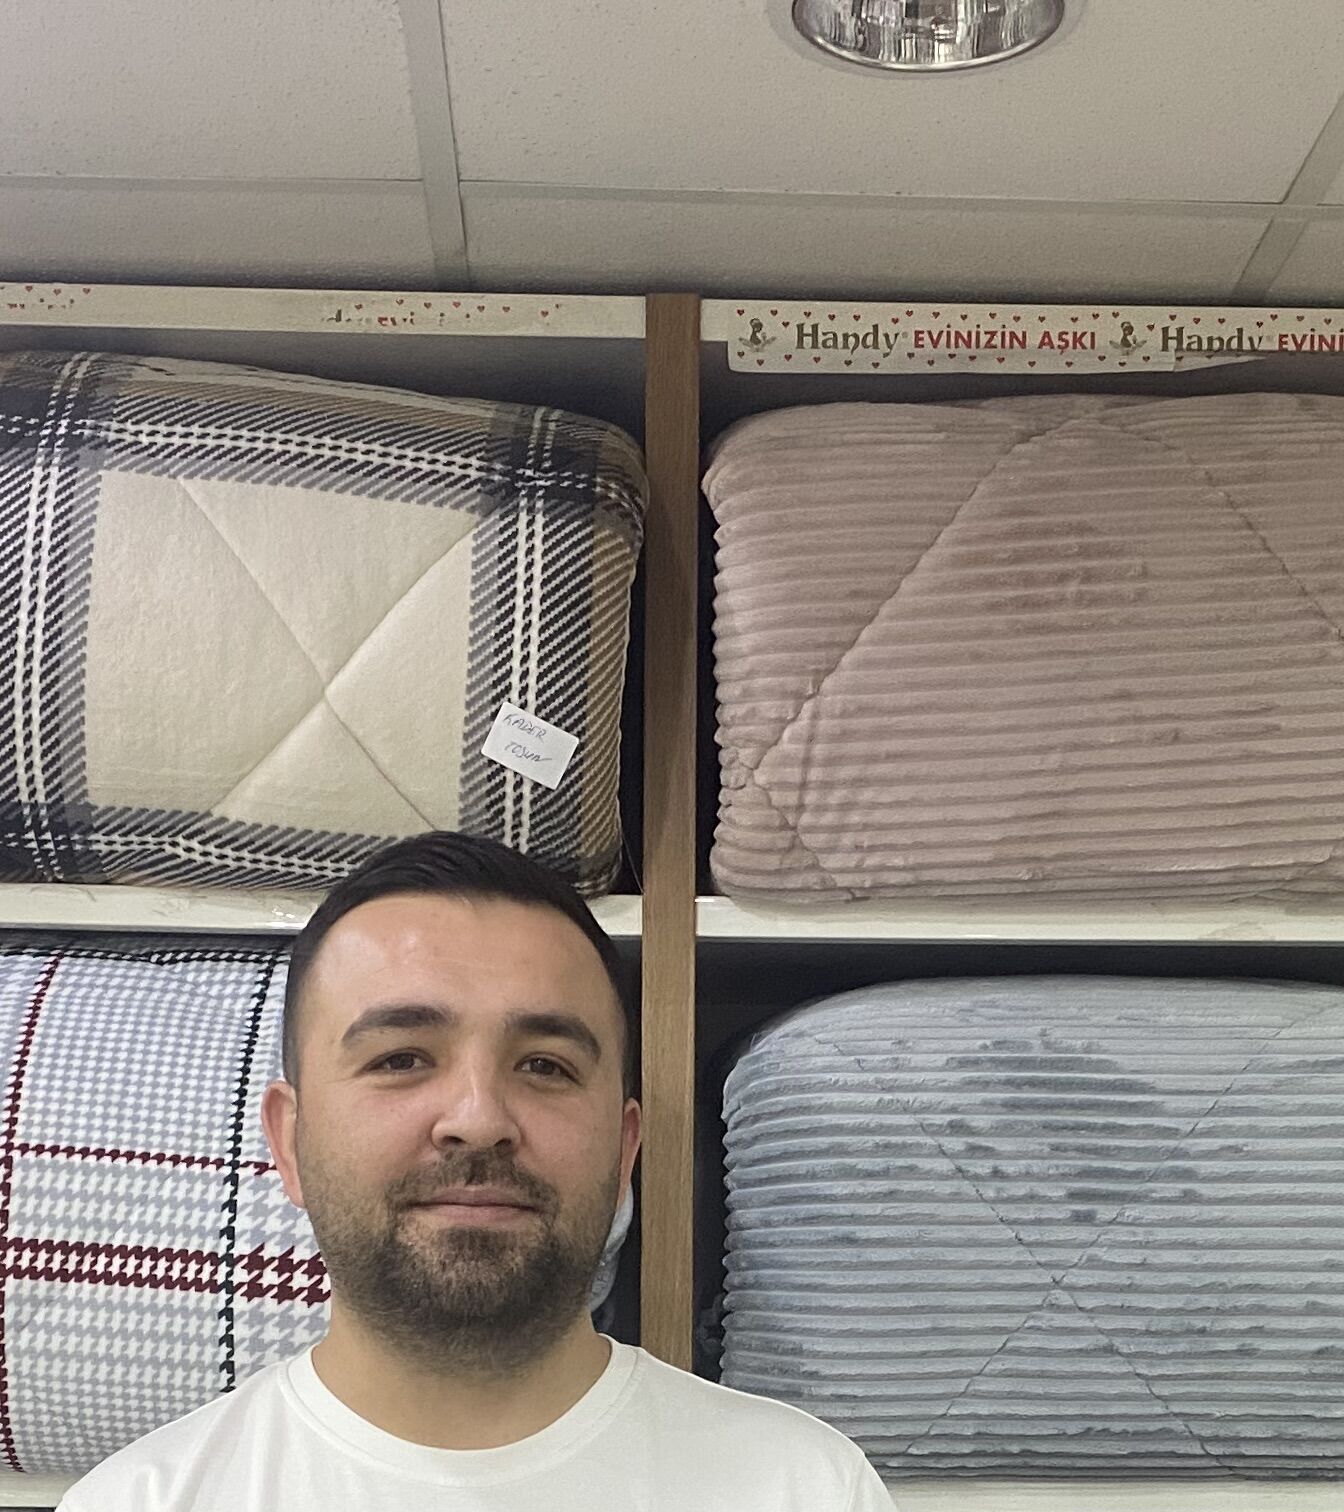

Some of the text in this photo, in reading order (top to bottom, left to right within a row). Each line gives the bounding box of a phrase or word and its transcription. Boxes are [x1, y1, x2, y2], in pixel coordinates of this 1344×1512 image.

[795, 322, 899, 358] Handy
[913, 324, 1028, 350] EVİNİZİN
[1038, 329, 1097, 355] AŞKI
[1161, 326, 1263, 351] Handy
